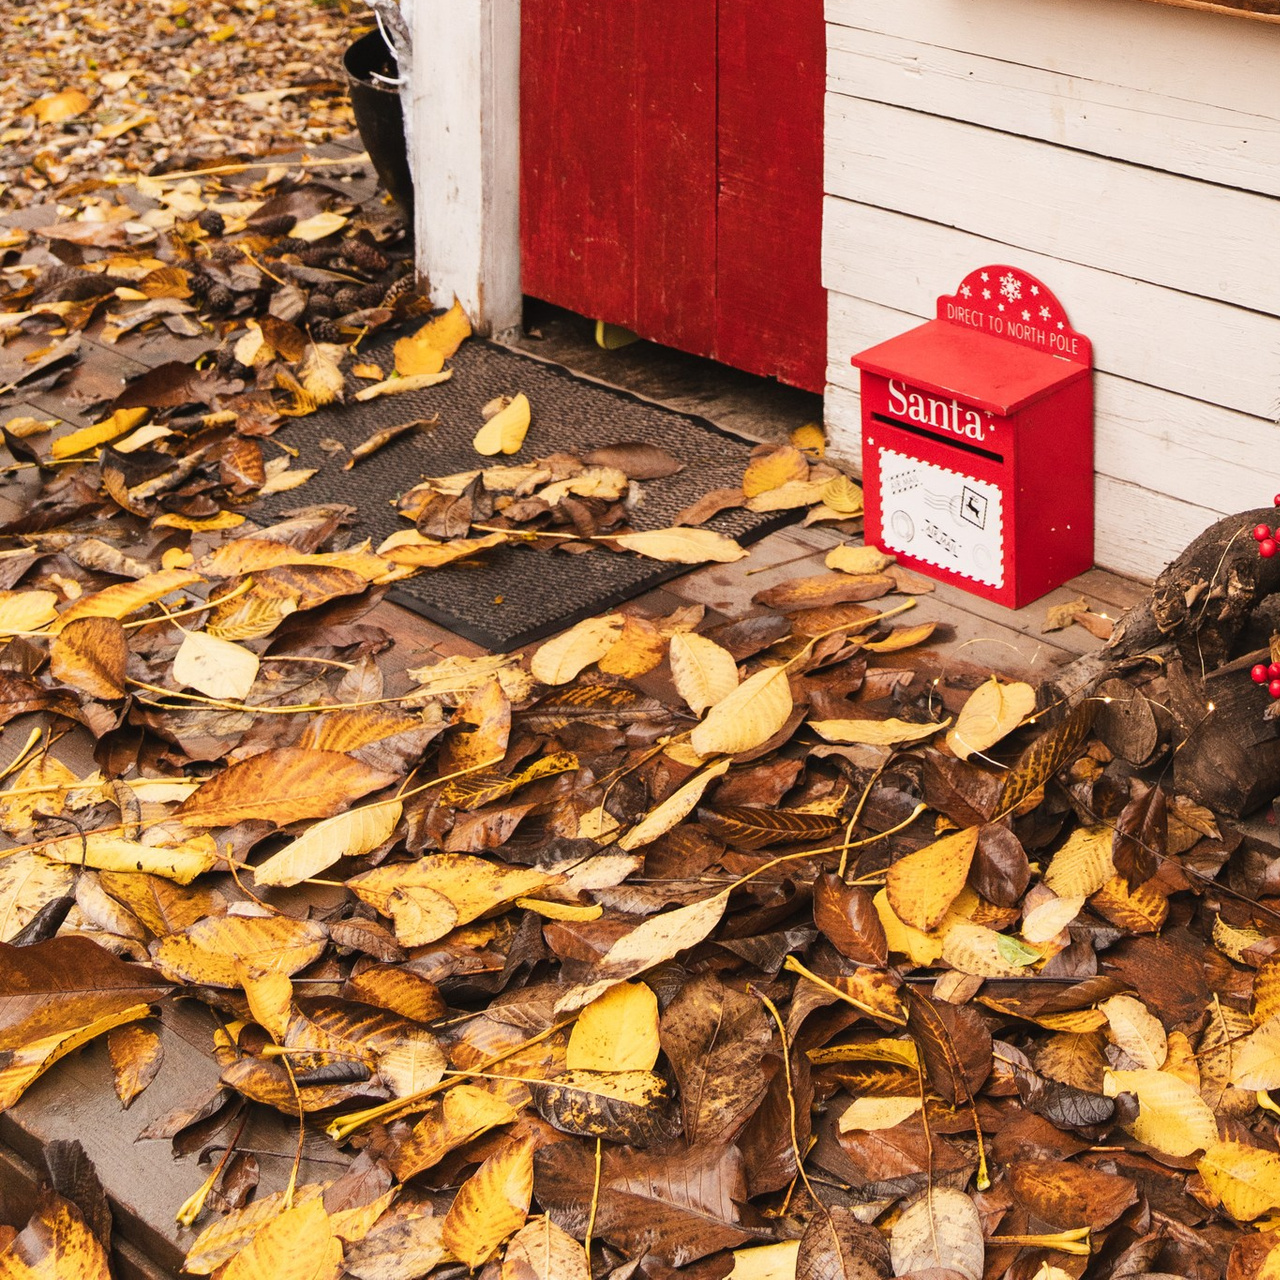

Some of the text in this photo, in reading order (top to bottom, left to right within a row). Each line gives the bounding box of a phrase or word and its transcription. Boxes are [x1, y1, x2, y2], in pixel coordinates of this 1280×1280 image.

[947, 303, 1078, 355] DIRECT TO NORTH POLE
[888, 379, 985, 441] Santa
[939, 536, 957, 553] MAIL
